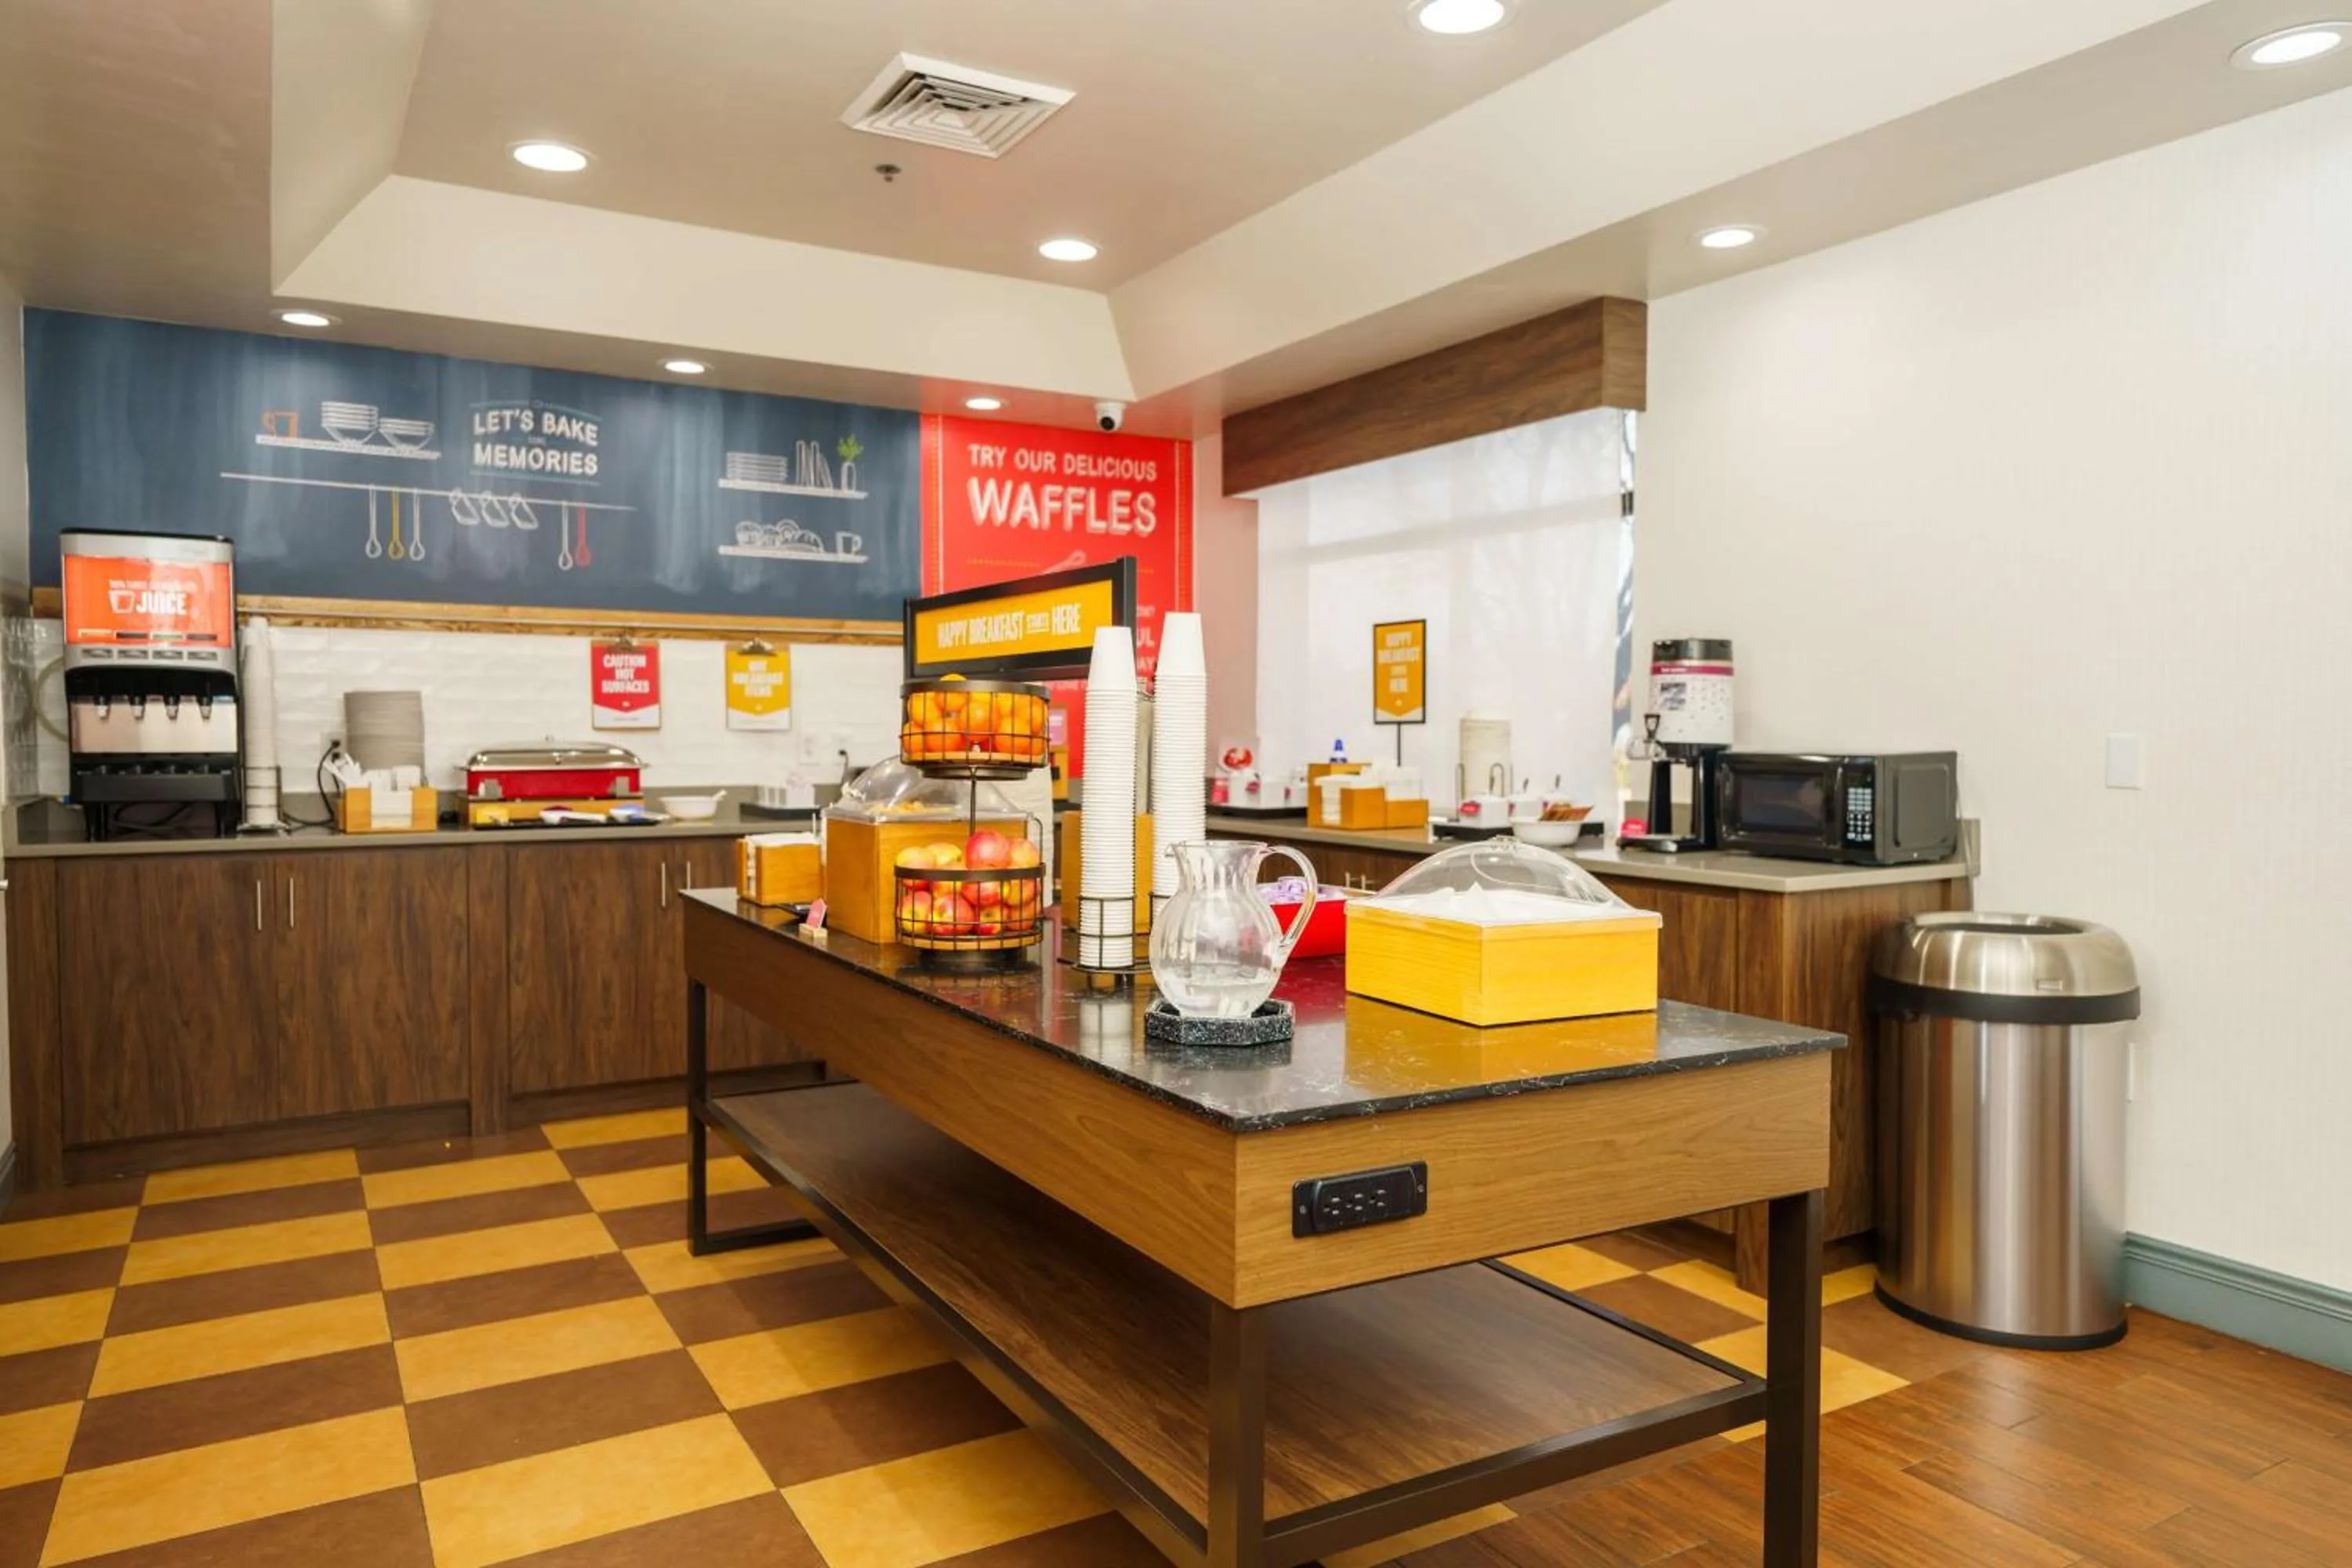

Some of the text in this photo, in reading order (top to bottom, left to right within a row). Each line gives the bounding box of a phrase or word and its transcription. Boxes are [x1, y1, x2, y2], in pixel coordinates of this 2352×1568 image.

[474, 408, 534, 435] LET'S
[542, 412, 598, 447] BAKE
[474, 443, 598, 476] MEMORIES
[968, 444, 1157, 481] TRY OUR DELICIOUS
[967, 477, 1157, 537] WAFFLES
[136, 590, 187, 615] JUICE
[938, 619, 969, 649] HAPPY
[969, 611, 1025, 645] BREAKFAST
[1051, 603, 1081, 636] HERE
[603, 654, 647, 668] CAUTION
[615, 667, 634, 681] HOT
[601, 680, 650, 694] SURFACES
